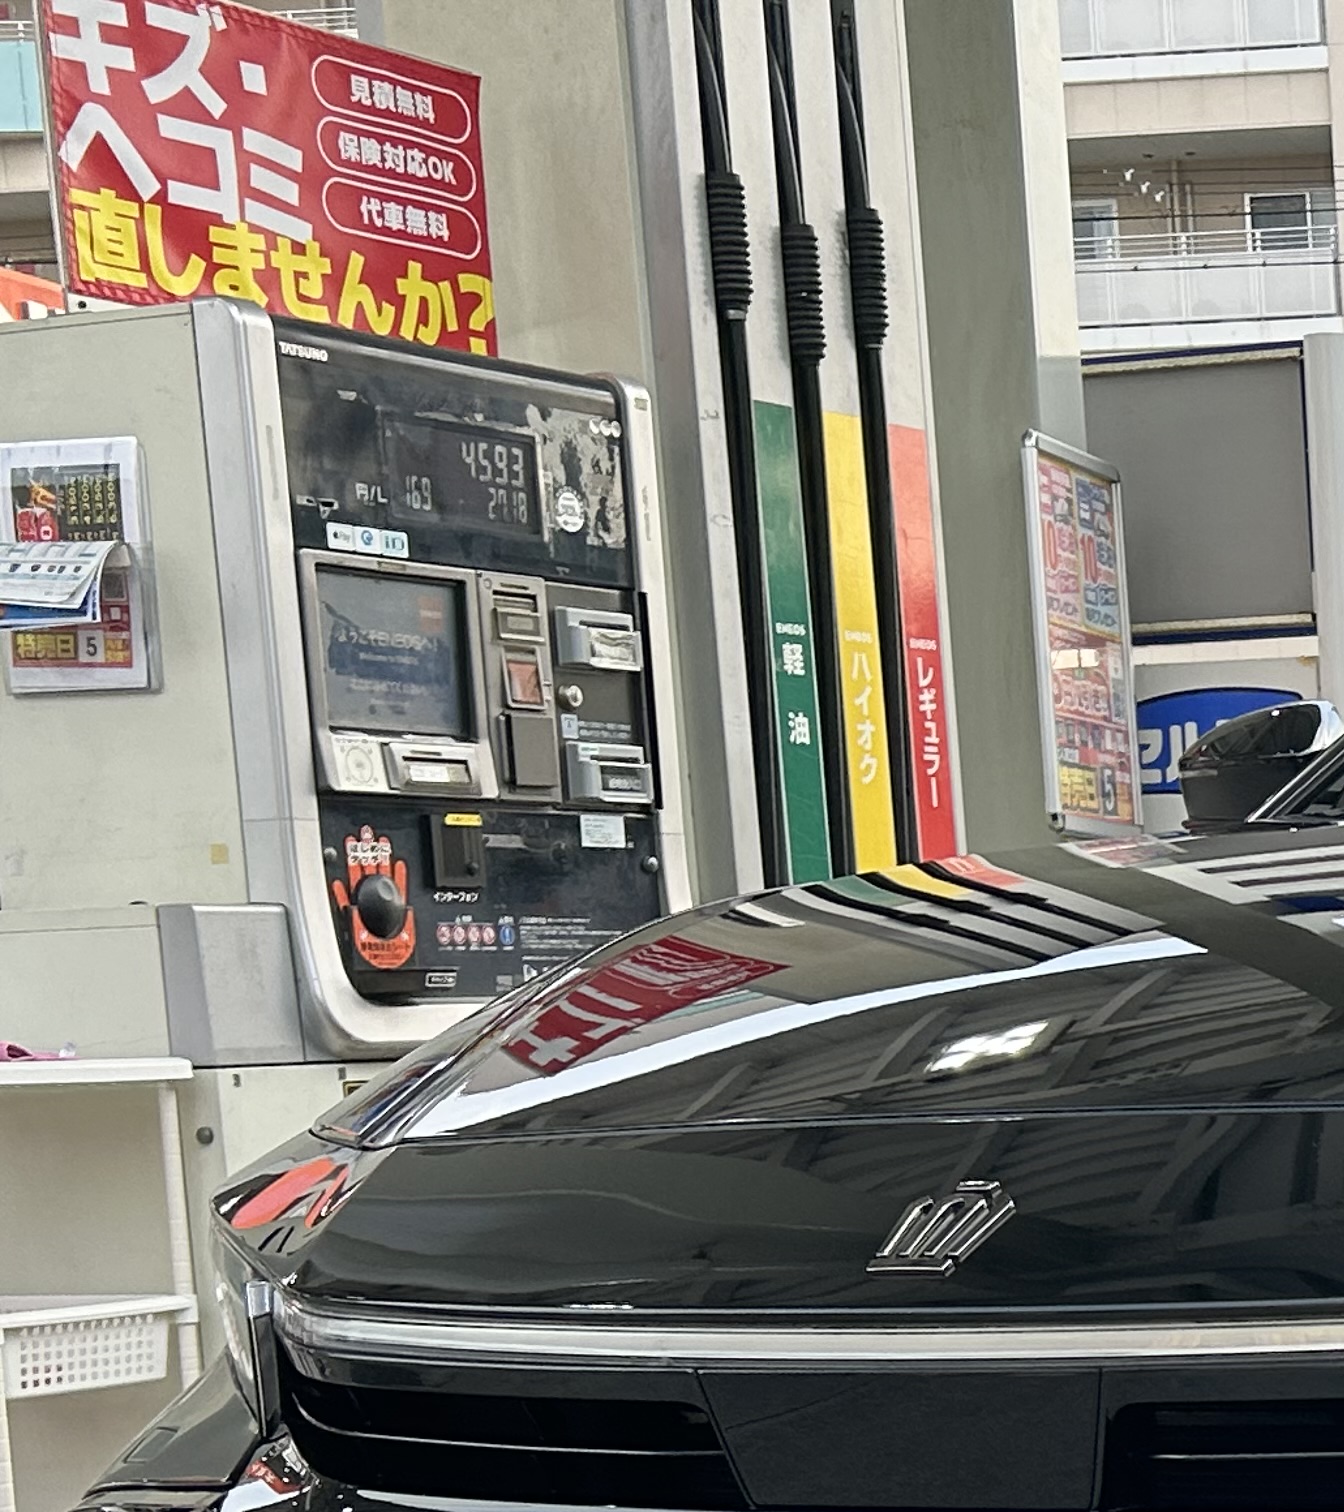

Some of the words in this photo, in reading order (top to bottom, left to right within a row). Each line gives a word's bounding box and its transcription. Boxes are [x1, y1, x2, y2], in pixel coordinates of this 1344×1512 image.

[350, 73, 436, 125] 見積無料
[58, 101, 314, 243] ヘコミ
[338, 130, 457, 186] 保険対応OK
[359, 195, 450, 243] 代車無料
[278, 341, 328, 362] TATSUNO
[461, 441, 526, 489] 4593
[16, 633, 75, 660] 特売日
[86, 636, 97, 657] 5
[850, 651, 878, 785] ハイオク
[916, 656, 941, 809] レギュラー
[1102, 768, 1116, 812] 5
